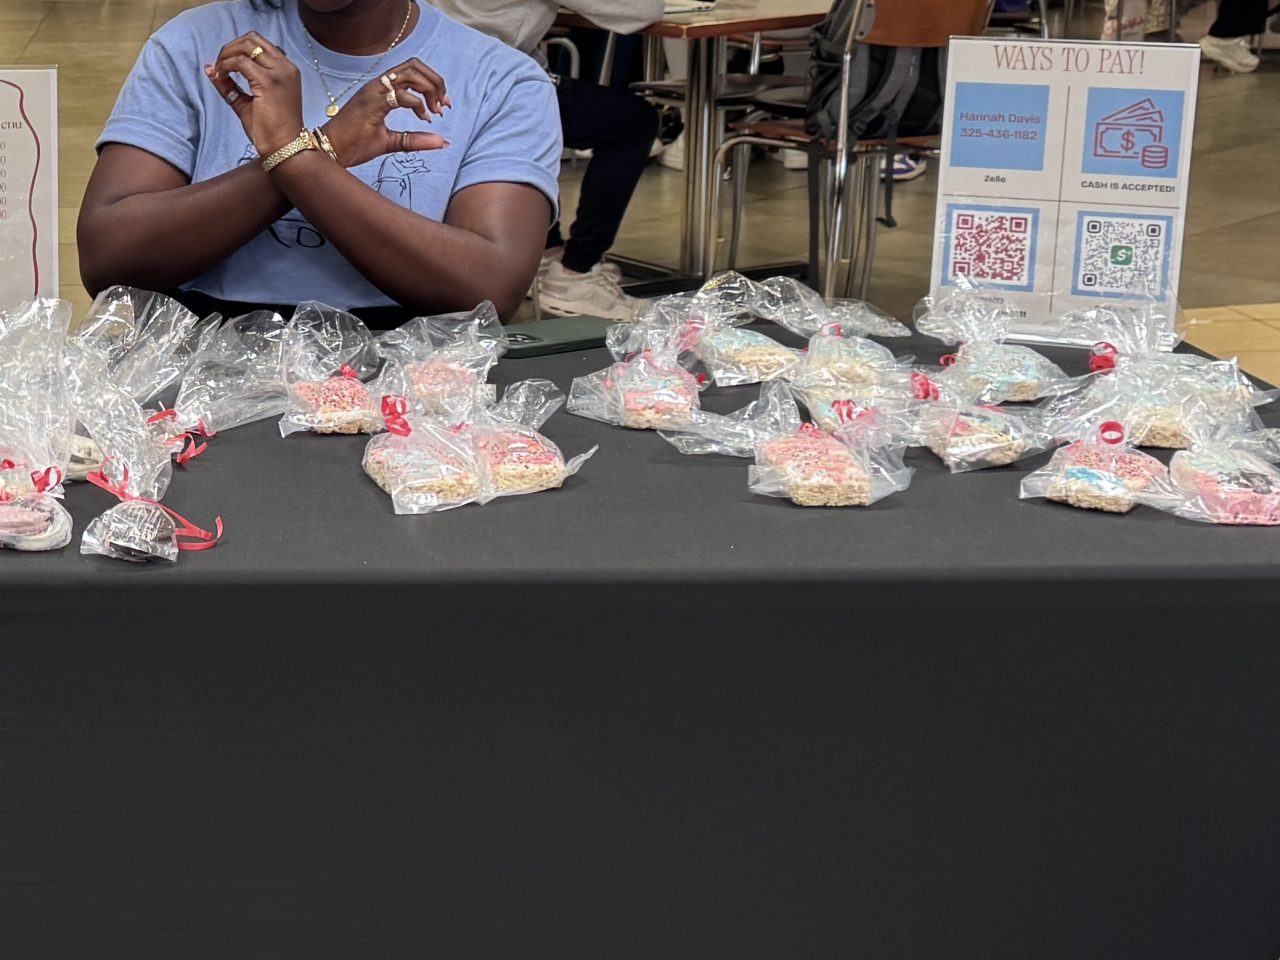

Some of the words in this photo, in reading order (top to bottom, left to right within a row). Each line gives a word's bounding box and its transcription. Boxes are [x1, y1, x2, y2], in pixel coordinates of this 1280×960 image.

[993, 45, 1053, 71] WAYS
[1062, 48, 1090, 72] TO
[1098, 49, 1145, 74] PAY!
[960, 112, 1005, 123] Hannah
[1008, 114, 1041, 124] Davis
[960, 128, 1038, 140] 325-436-1182
[984, 175, 1006, 183] Zelle
[1081, 181, 1108, 190] CASH
[1121, 183, 1175, 193] ACCEPTED!
